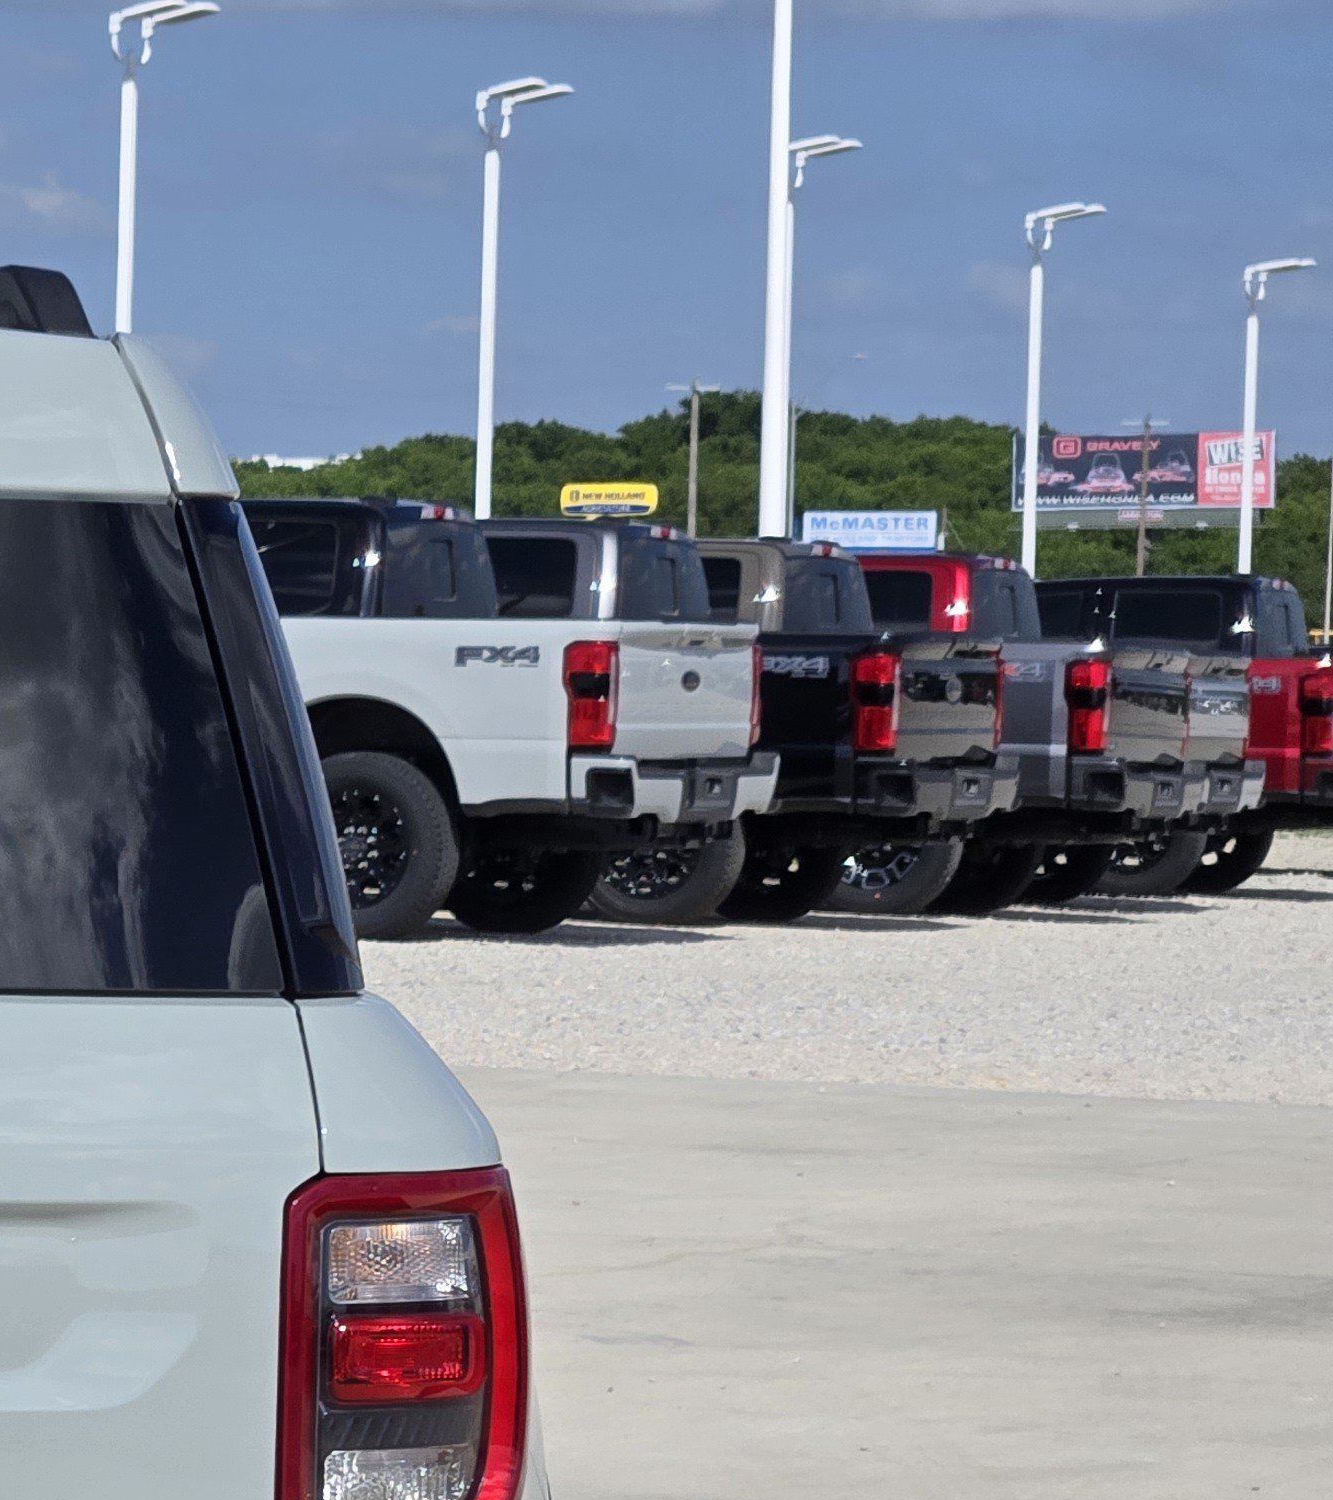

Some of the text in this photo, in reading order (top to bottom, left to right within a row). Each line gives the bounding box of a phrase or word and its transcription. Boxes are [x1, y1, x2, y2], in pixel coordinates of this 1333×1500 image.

[1087, 439, 1160, 451] GRAVEY
[1205, 468, 1265, 485] Hona
[810, 517, 929, 531] McMASTER
[453, 646, 540, 668] FX4
